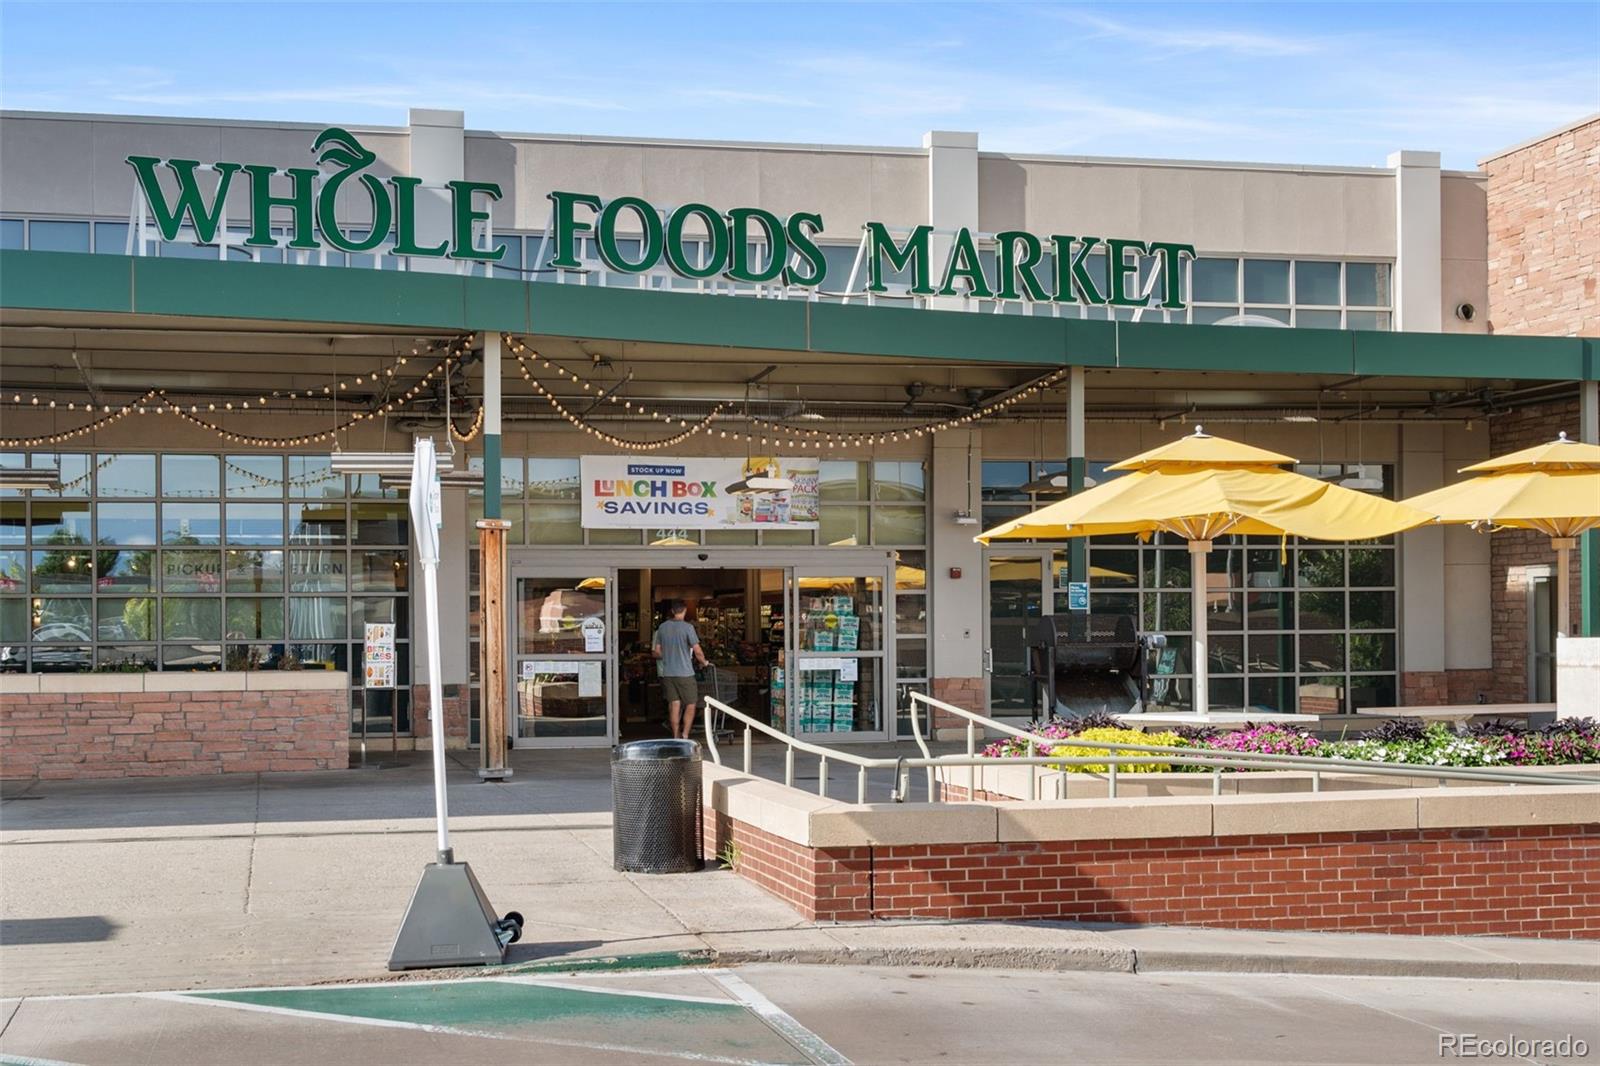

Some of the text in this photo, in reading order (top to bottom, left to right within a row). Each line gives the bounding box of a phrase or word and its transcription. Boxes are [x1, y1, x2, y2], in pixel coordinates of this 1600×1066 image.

[125, 128, 1197, 310] WHOLE FOODS MARKET
[594, 480, 717, 498] LUNCH BOX
[793, 484, 818, 493] PACK
[604, 501, 709, 514] SAVINGS
[656, 528, 688, 540] 444
